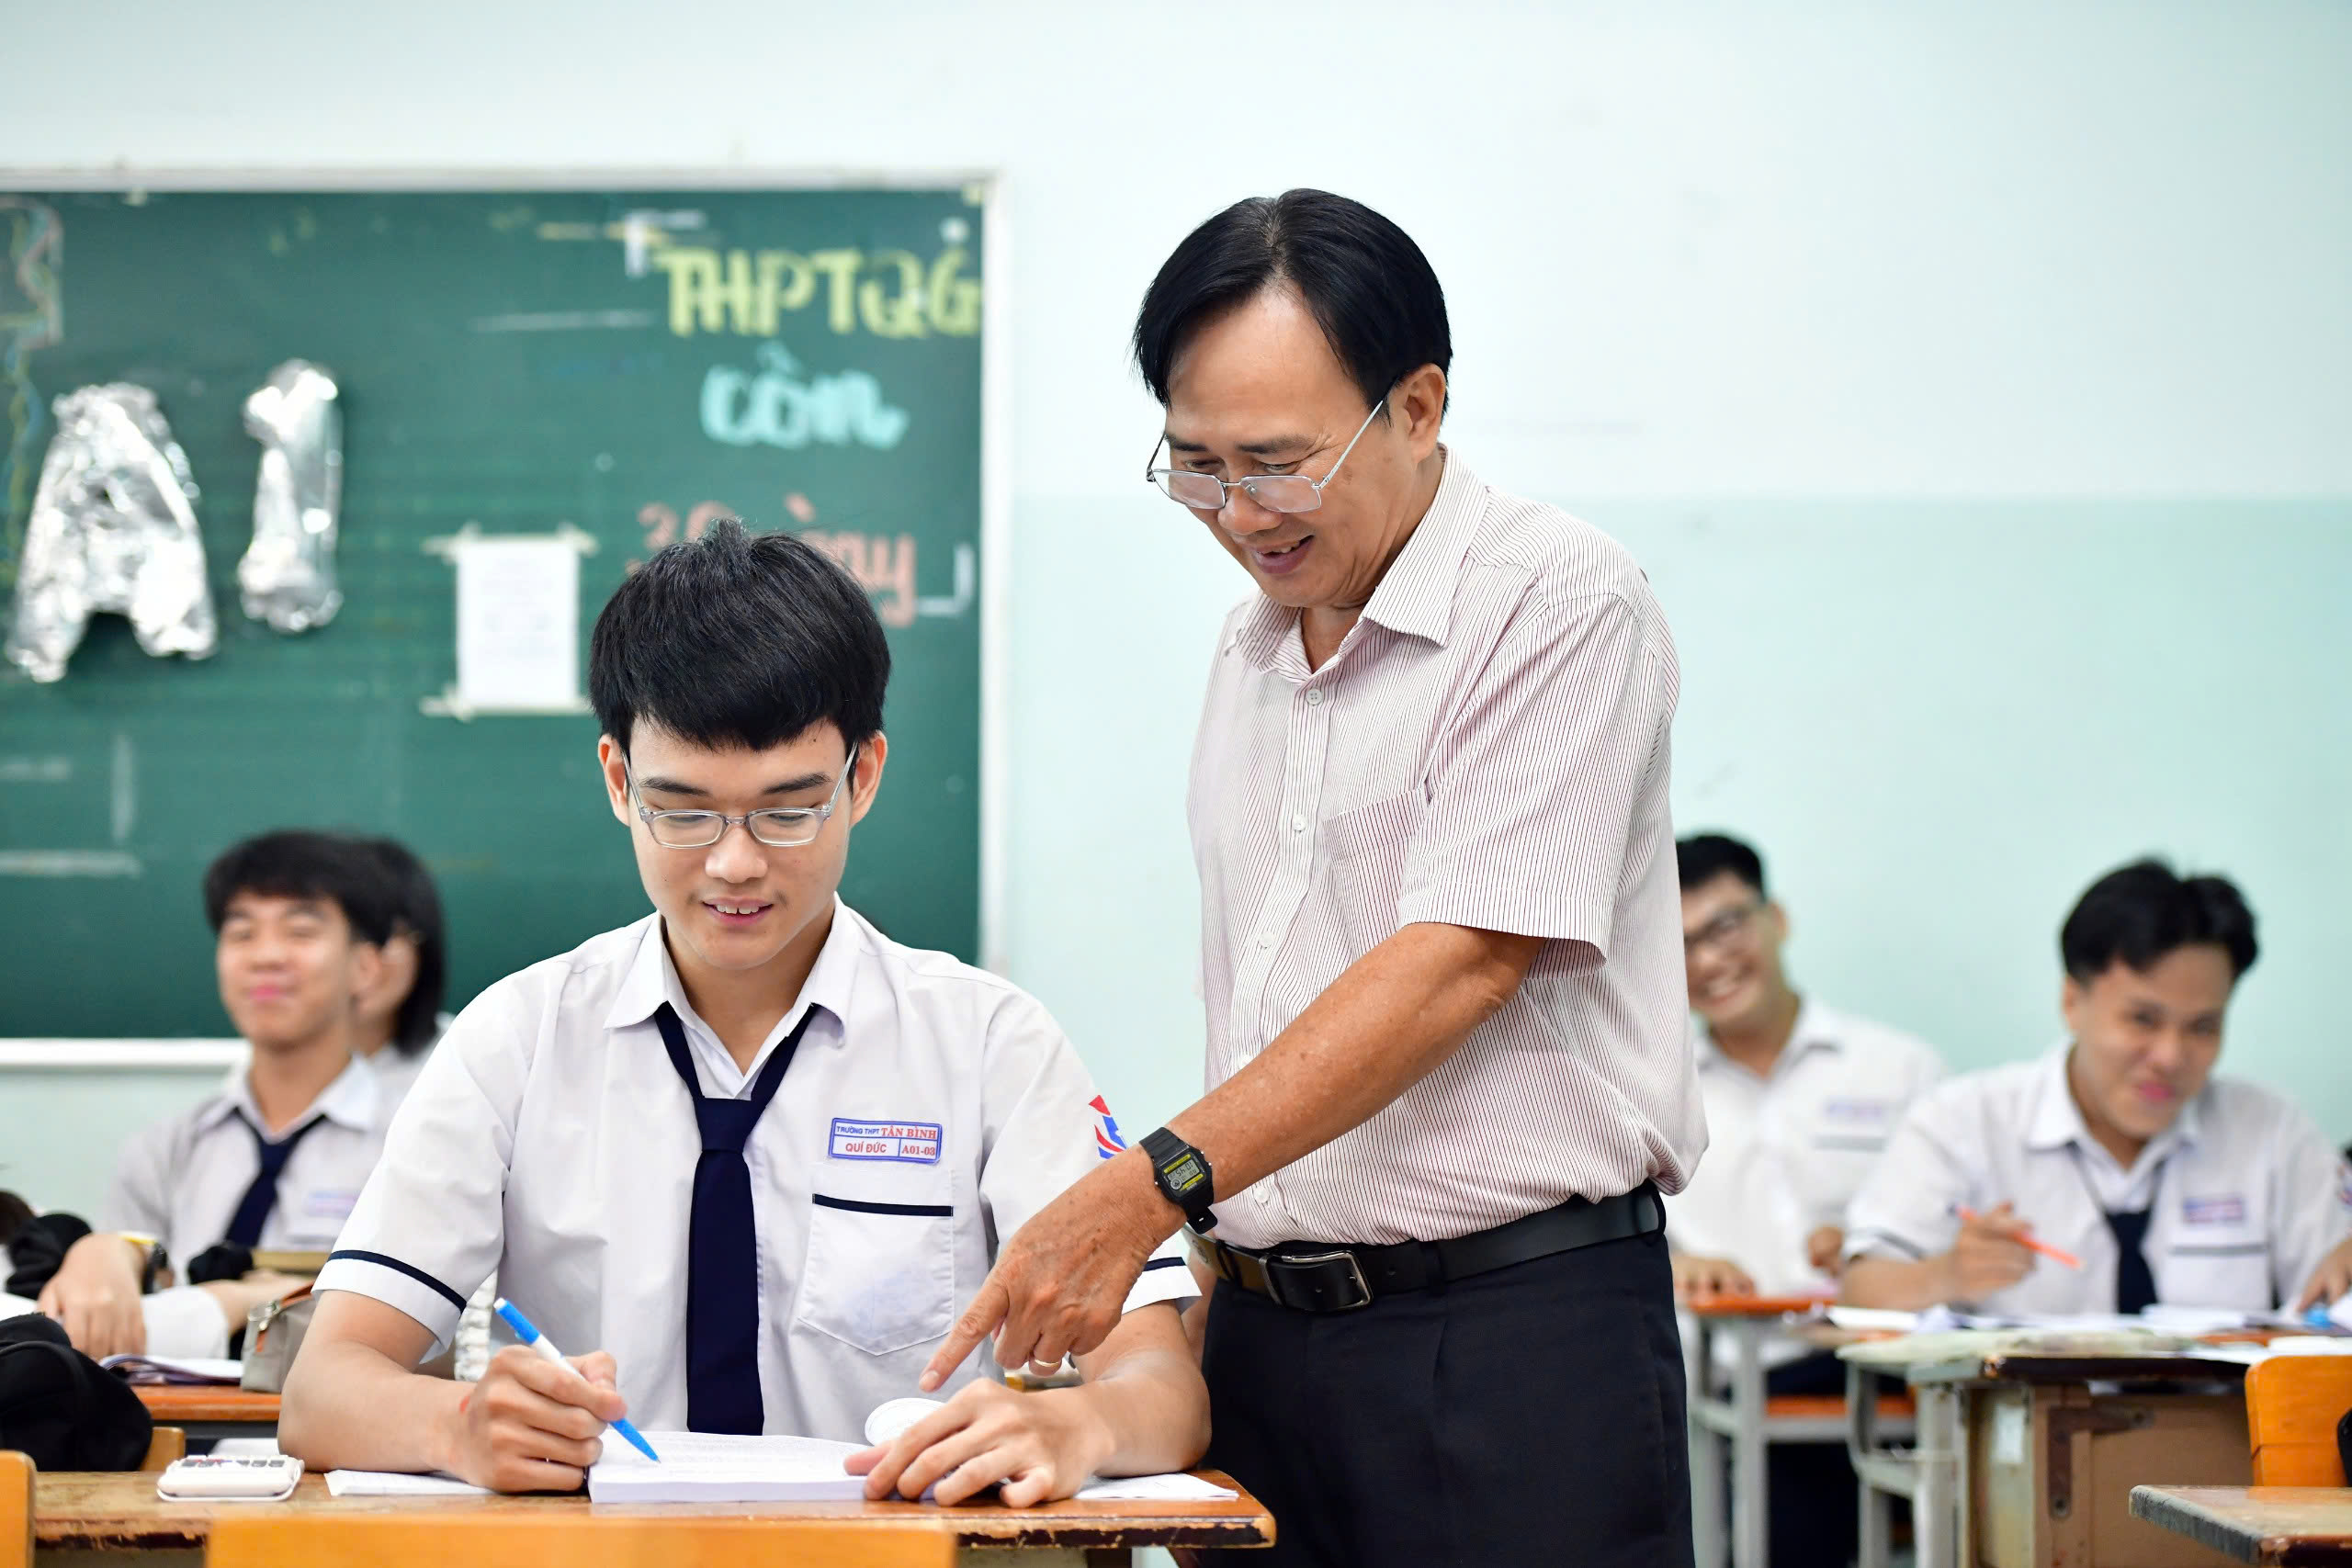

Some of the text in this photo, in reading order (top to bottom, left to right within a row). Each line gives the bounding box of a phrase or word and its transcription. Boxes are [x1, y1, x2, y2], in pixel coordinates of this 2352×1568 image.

[836, 1125, 863, 1134] TRƯỜNG
[881, 1125, 904, 1137] TÂN
[907, 1124, 937, 1139] BÌNH
[845, 1141, 887, 1153] QUÍ ĐỨC
[901, 1145, 935, 1156] A01-03
